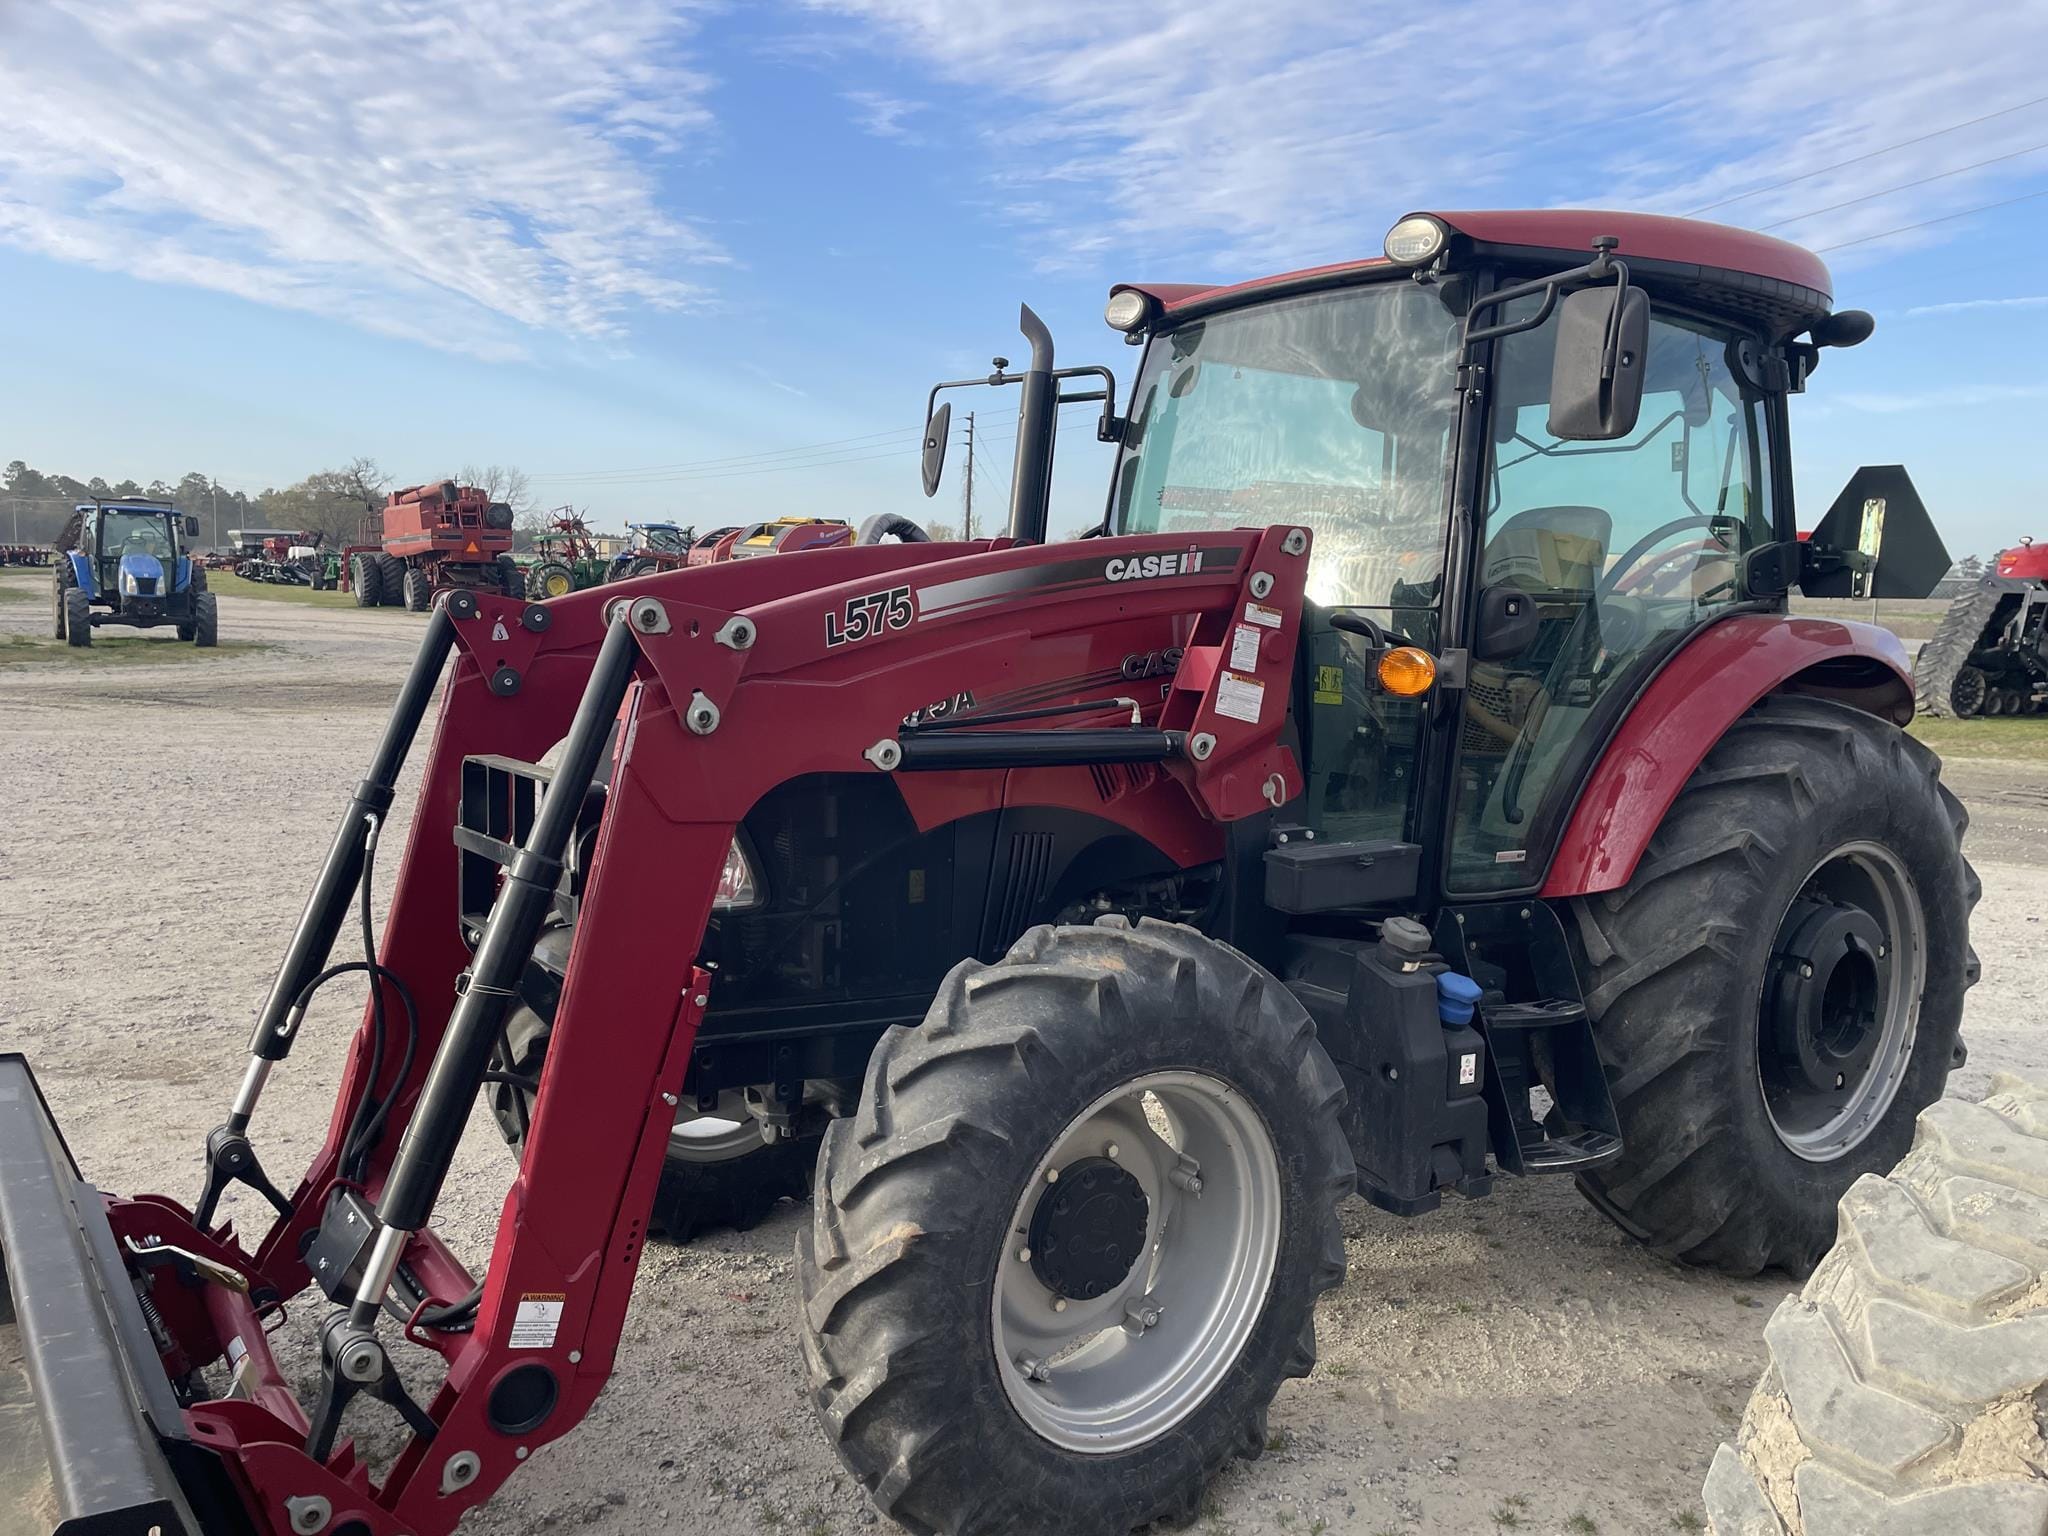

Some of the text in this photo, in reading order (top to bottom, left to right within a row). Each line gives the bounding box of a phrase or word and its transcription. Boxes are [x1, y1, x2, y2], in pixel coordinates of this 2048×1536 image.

[1105, 554, 1178, 582] CASE
[825, 585, 913, 648] L575
[1121, 646, 1183, 681] CAS
